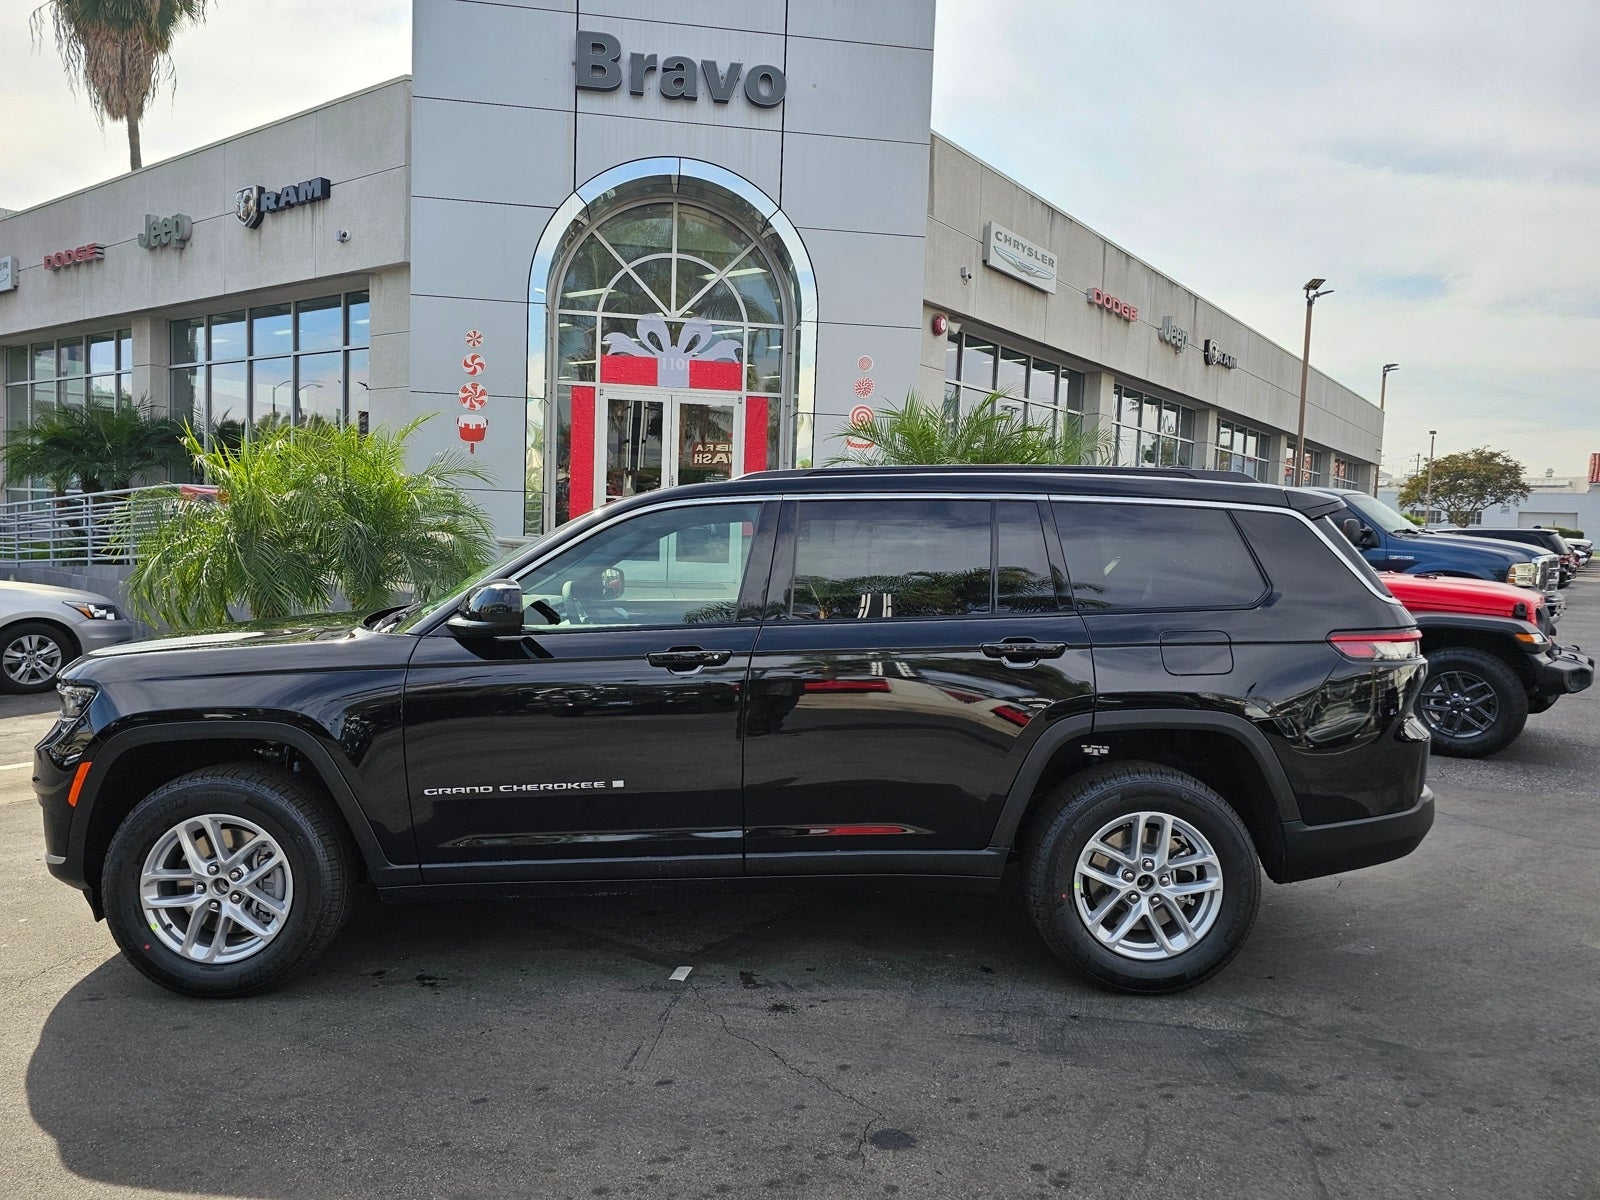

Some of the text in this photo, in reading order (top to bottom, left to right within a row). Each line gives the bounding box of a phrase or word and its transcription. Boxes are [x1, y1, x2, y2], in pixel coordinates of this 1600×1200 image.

[576, 30, 787, 108] Bravo
[260, 177, 329, 213] RAM
[138, 213, 191, 249] Jeep
[994, 230, 1055, 268] CHRYSLER
[44, 243, 101, 270] DODGE
[1089, 288, 1138, 322] DODGE
[1160, 316, 1188, 353] Jeep
[1217, 350, 1238, 369] RAM
[424, 781, 606, 796] GRAND CHEROKEE
